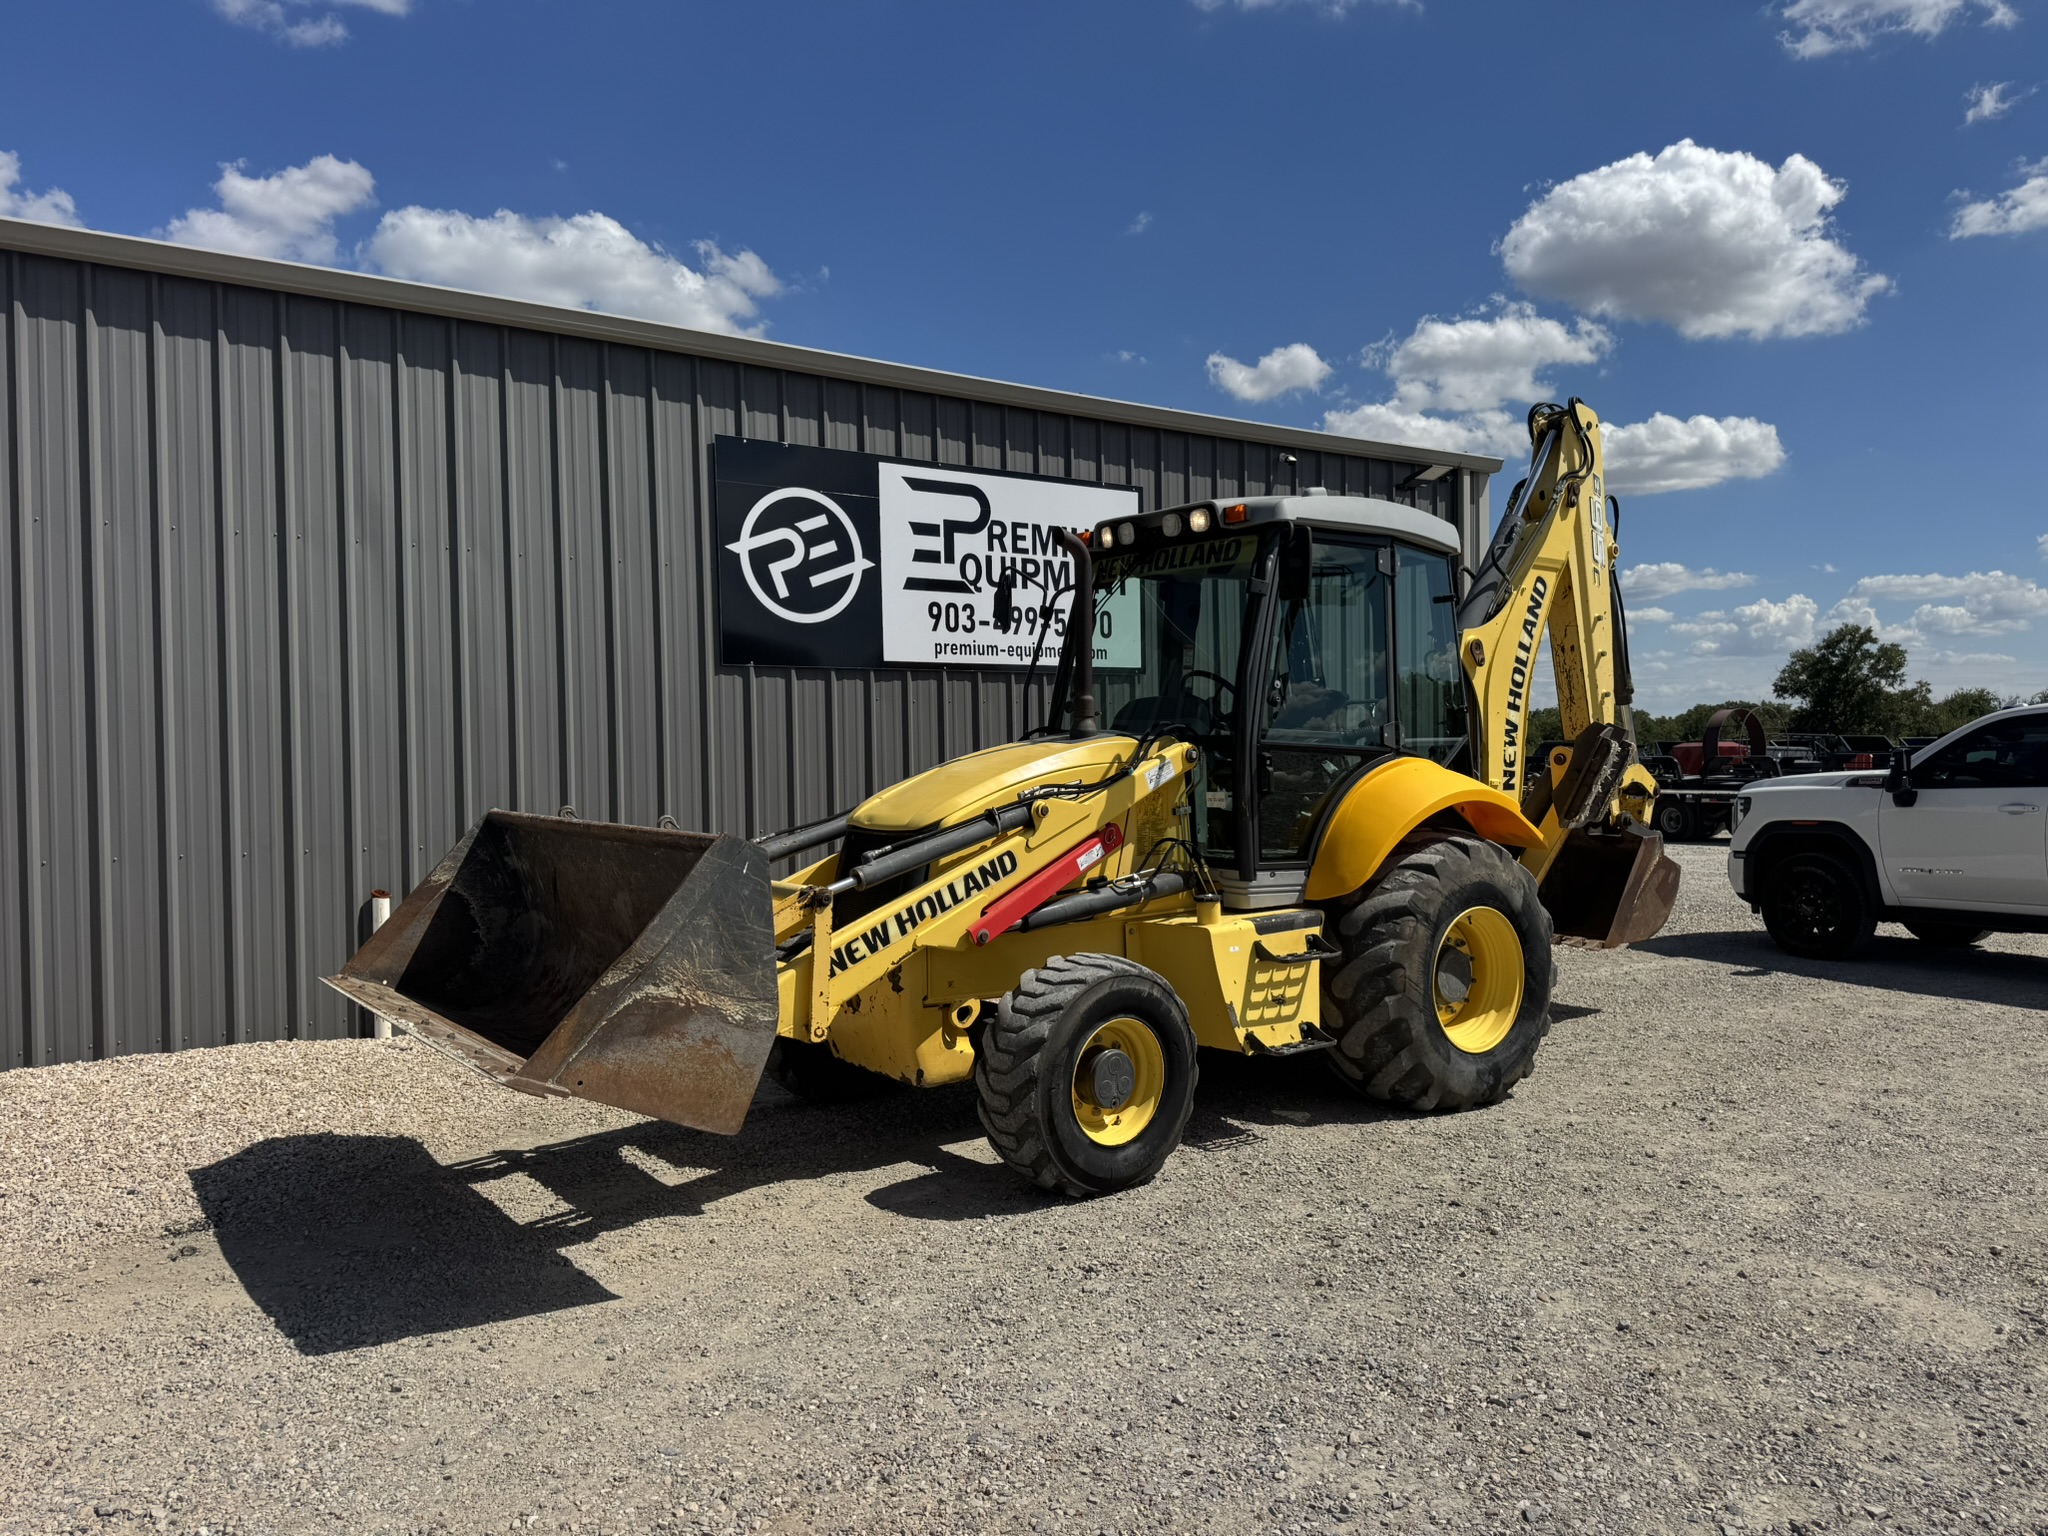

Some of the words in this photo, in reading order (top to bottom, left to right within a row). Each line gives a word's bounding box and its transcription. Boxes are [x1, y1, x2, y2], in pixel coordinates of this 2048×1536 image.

[927, 601, 1113, 639] 903-99-50
[1506, 575, 1548, 713] HOLLAND
[1501, 718, 1519, 791] NEW
[830, 919, 891, 978] NEW
[894, 849, 1018, 937] HOLLAND
